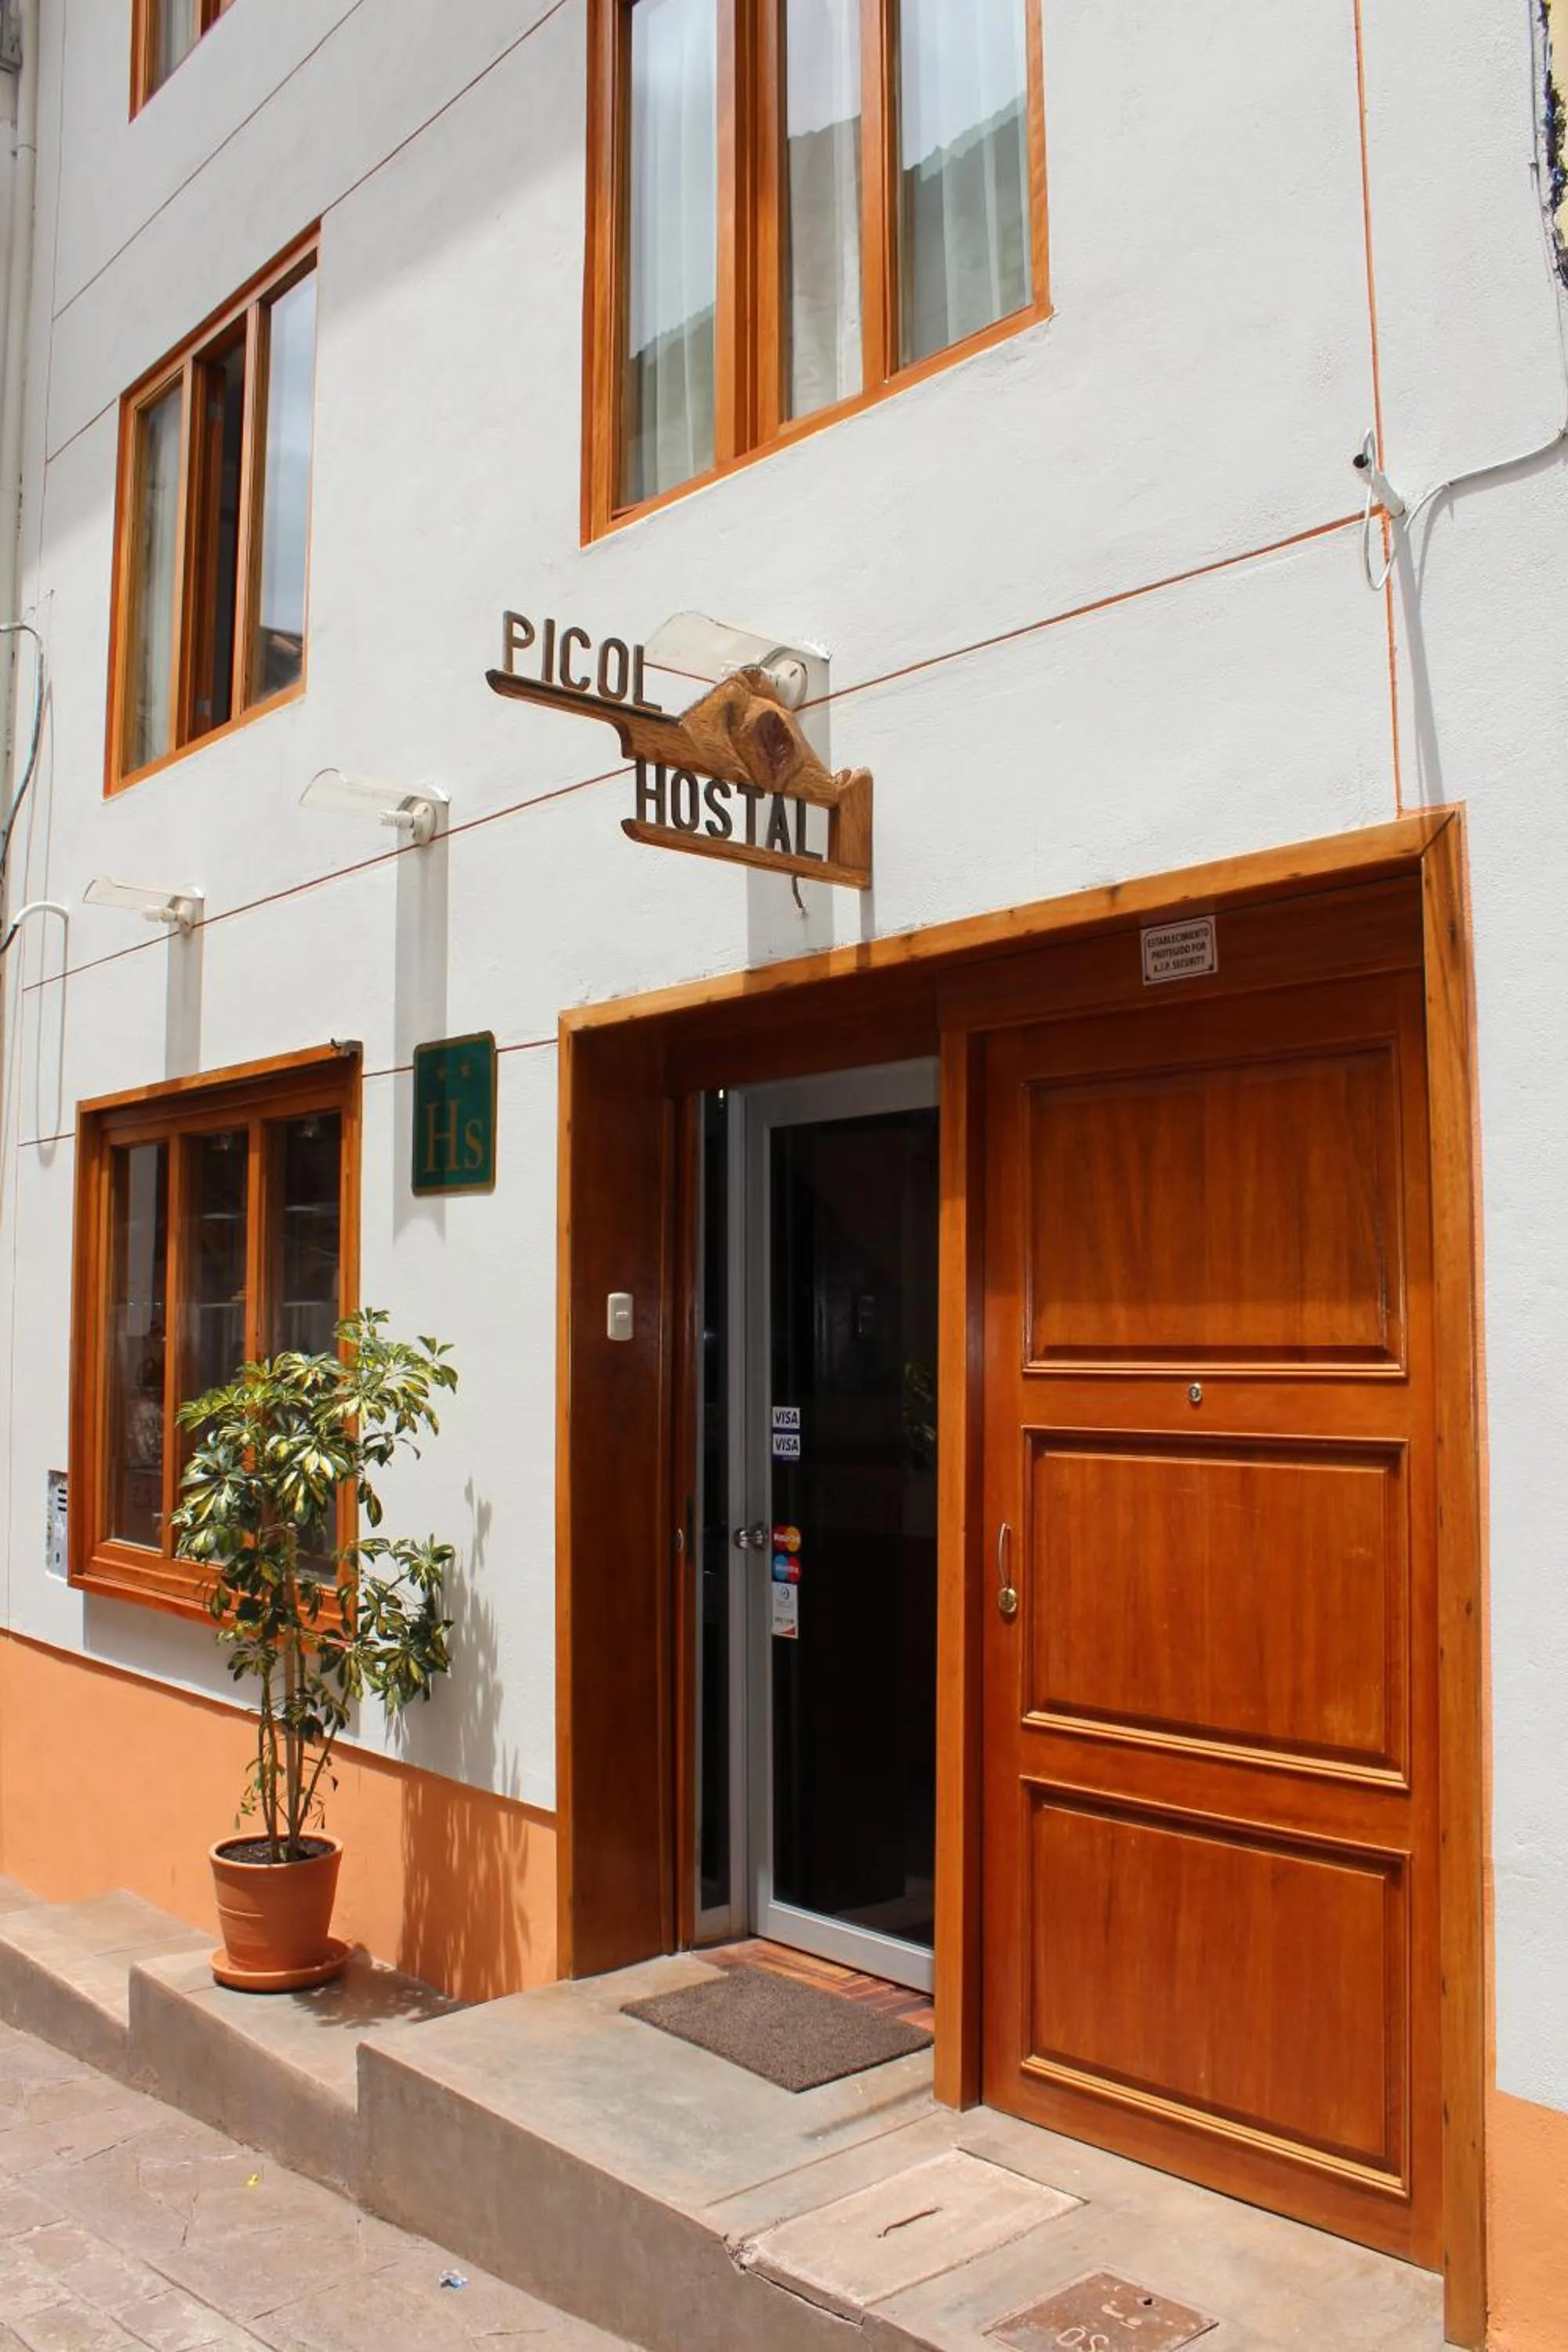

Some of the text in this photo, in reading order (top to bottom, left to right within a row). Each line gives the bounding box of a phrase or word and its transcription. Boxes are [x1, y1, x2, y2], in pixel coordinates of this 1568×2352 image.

[503, 610, 662, 712] PICOL
[635, 757, 823, 861] HOSTAL
[1147, 927, 1209, 948] ESTABLECIMIENTO
[1152, 941, 1207, 959] PROTEGIDO POR
[1172, 956, 1205, 970] SECURITY
[423, 1098, 485, 1172] Hs
[775, 1410, 798, 1425] VISA
[775, 1438, 799, 1451] VISA
